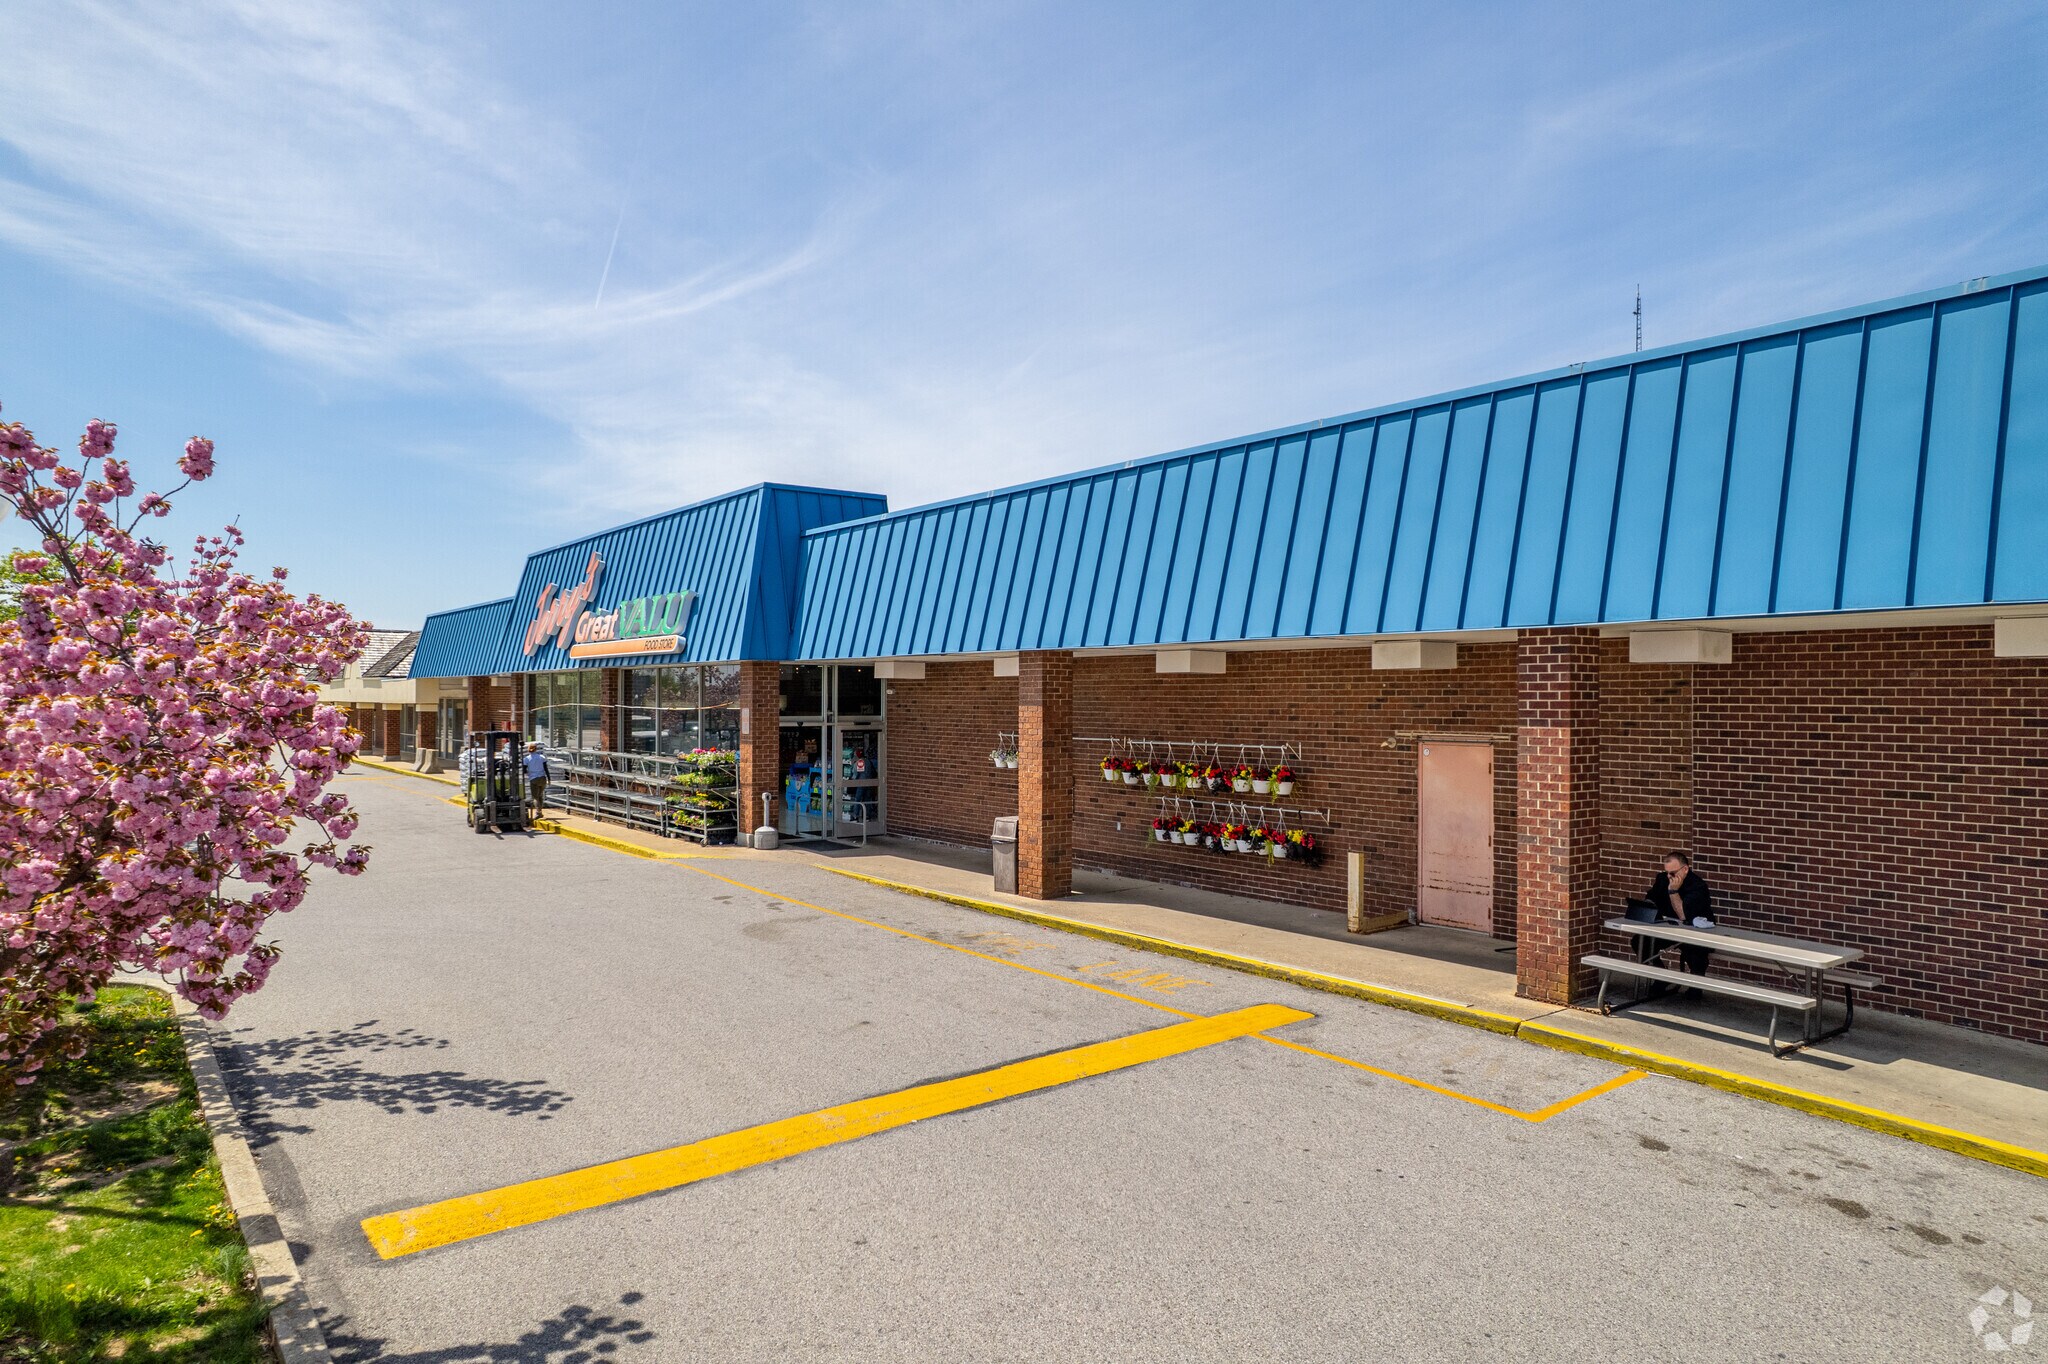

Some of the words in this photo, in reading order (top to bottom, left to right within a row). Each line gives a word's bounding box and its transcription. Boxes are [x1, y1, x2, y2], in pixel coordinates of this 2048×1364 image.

[574, 608, 620, 643] Great
[618, 589, 698, 638] VALU
[644, 640, 659, 650] FOOD
[658, 638, 675, 649] STORE
